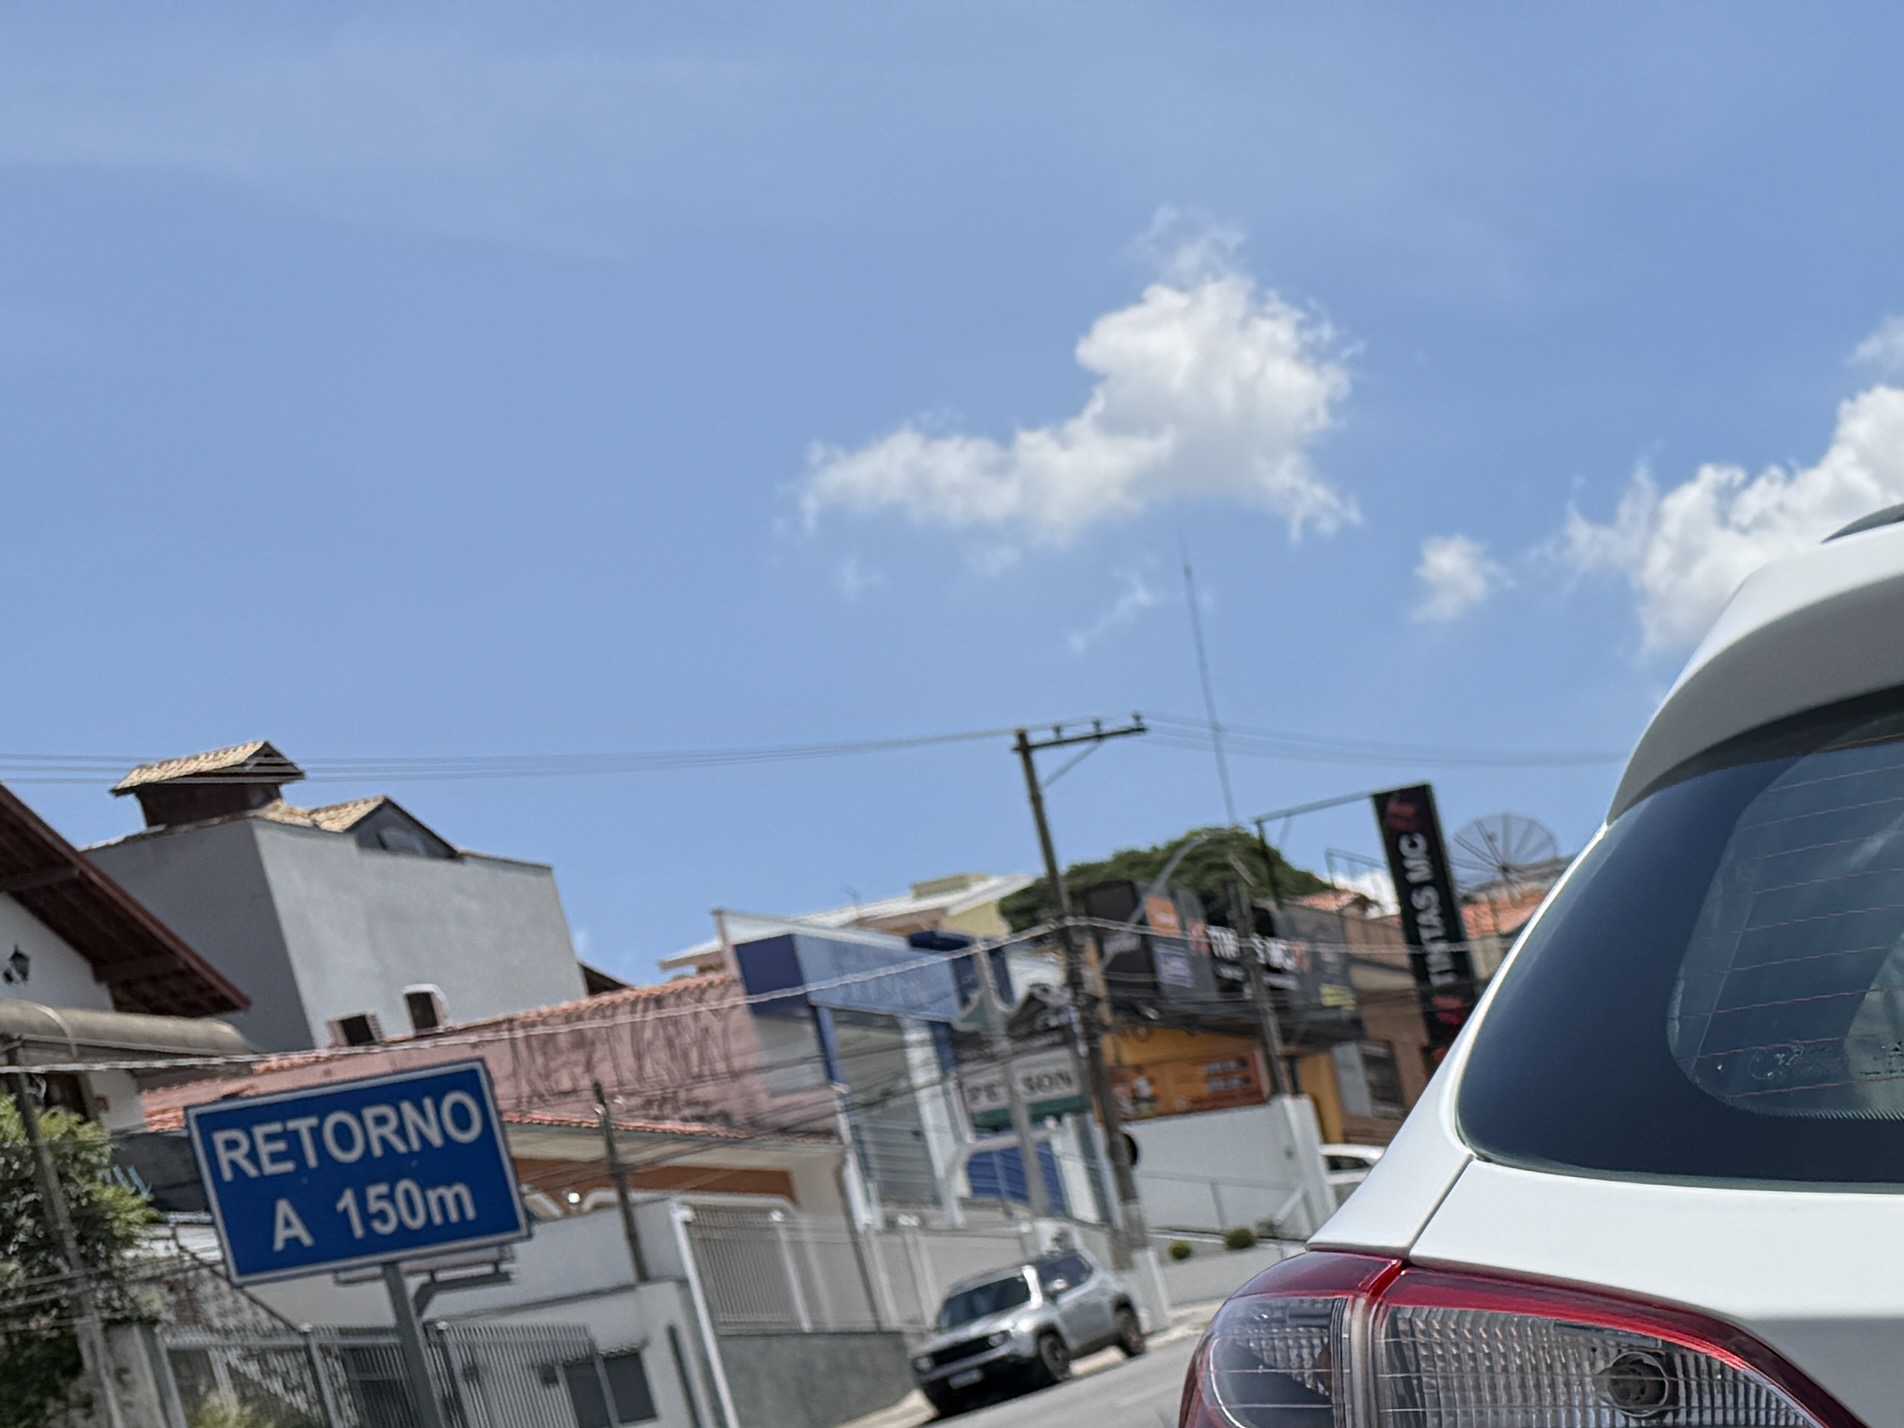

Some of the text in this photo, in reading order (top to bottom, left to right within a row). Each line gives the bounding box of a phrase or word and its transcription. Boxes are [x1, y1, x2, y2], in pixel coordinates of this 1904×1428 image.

[1398, 831, 1434, 884] MC
[212, 1090, 484, 1183] RETORNO
[272, 1177, 477, 1252] A 150m
